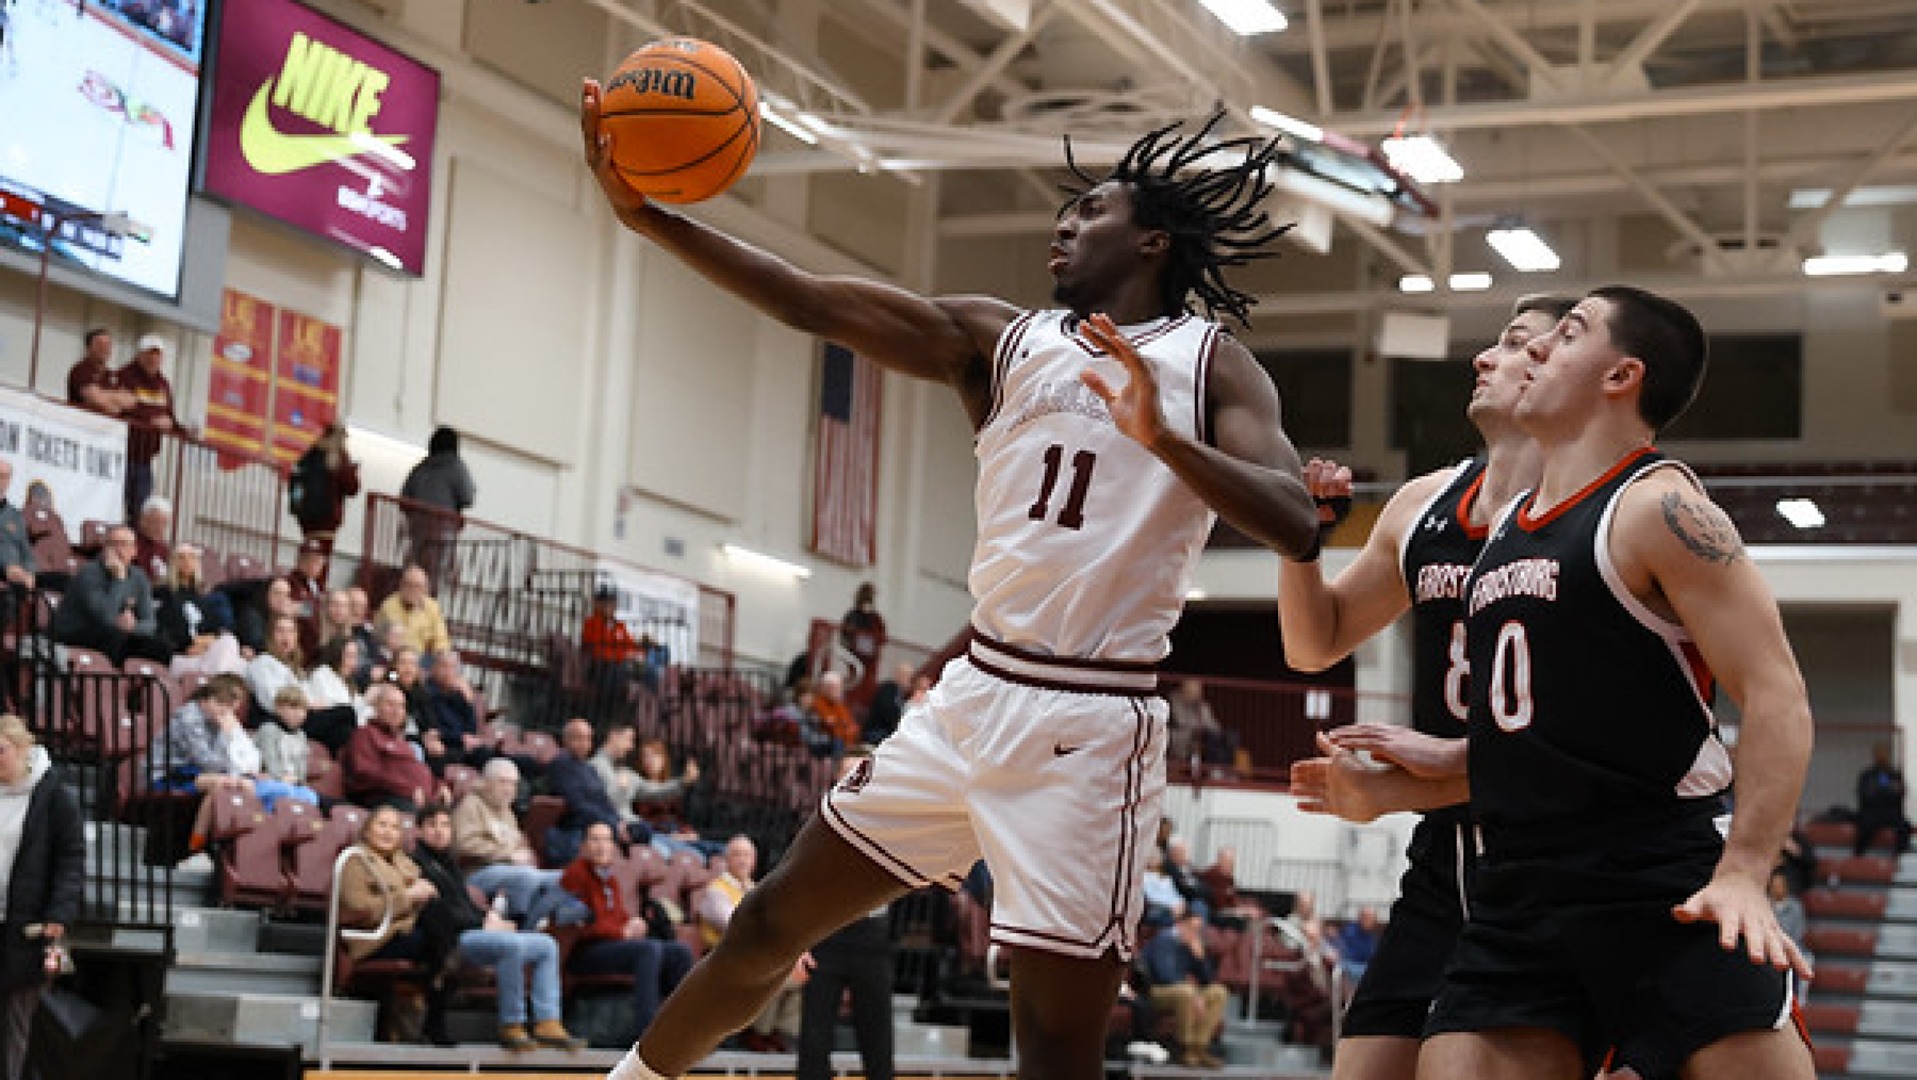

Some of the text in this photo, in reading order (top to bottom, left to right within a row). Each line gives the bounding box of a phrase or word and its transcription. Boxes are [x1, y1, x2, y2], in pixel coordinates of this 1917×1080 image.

[273, 31, 390, 136] NIKE
[1029, 444, 1096, 530] 11
[1489, 619, 1534, 732] 0
